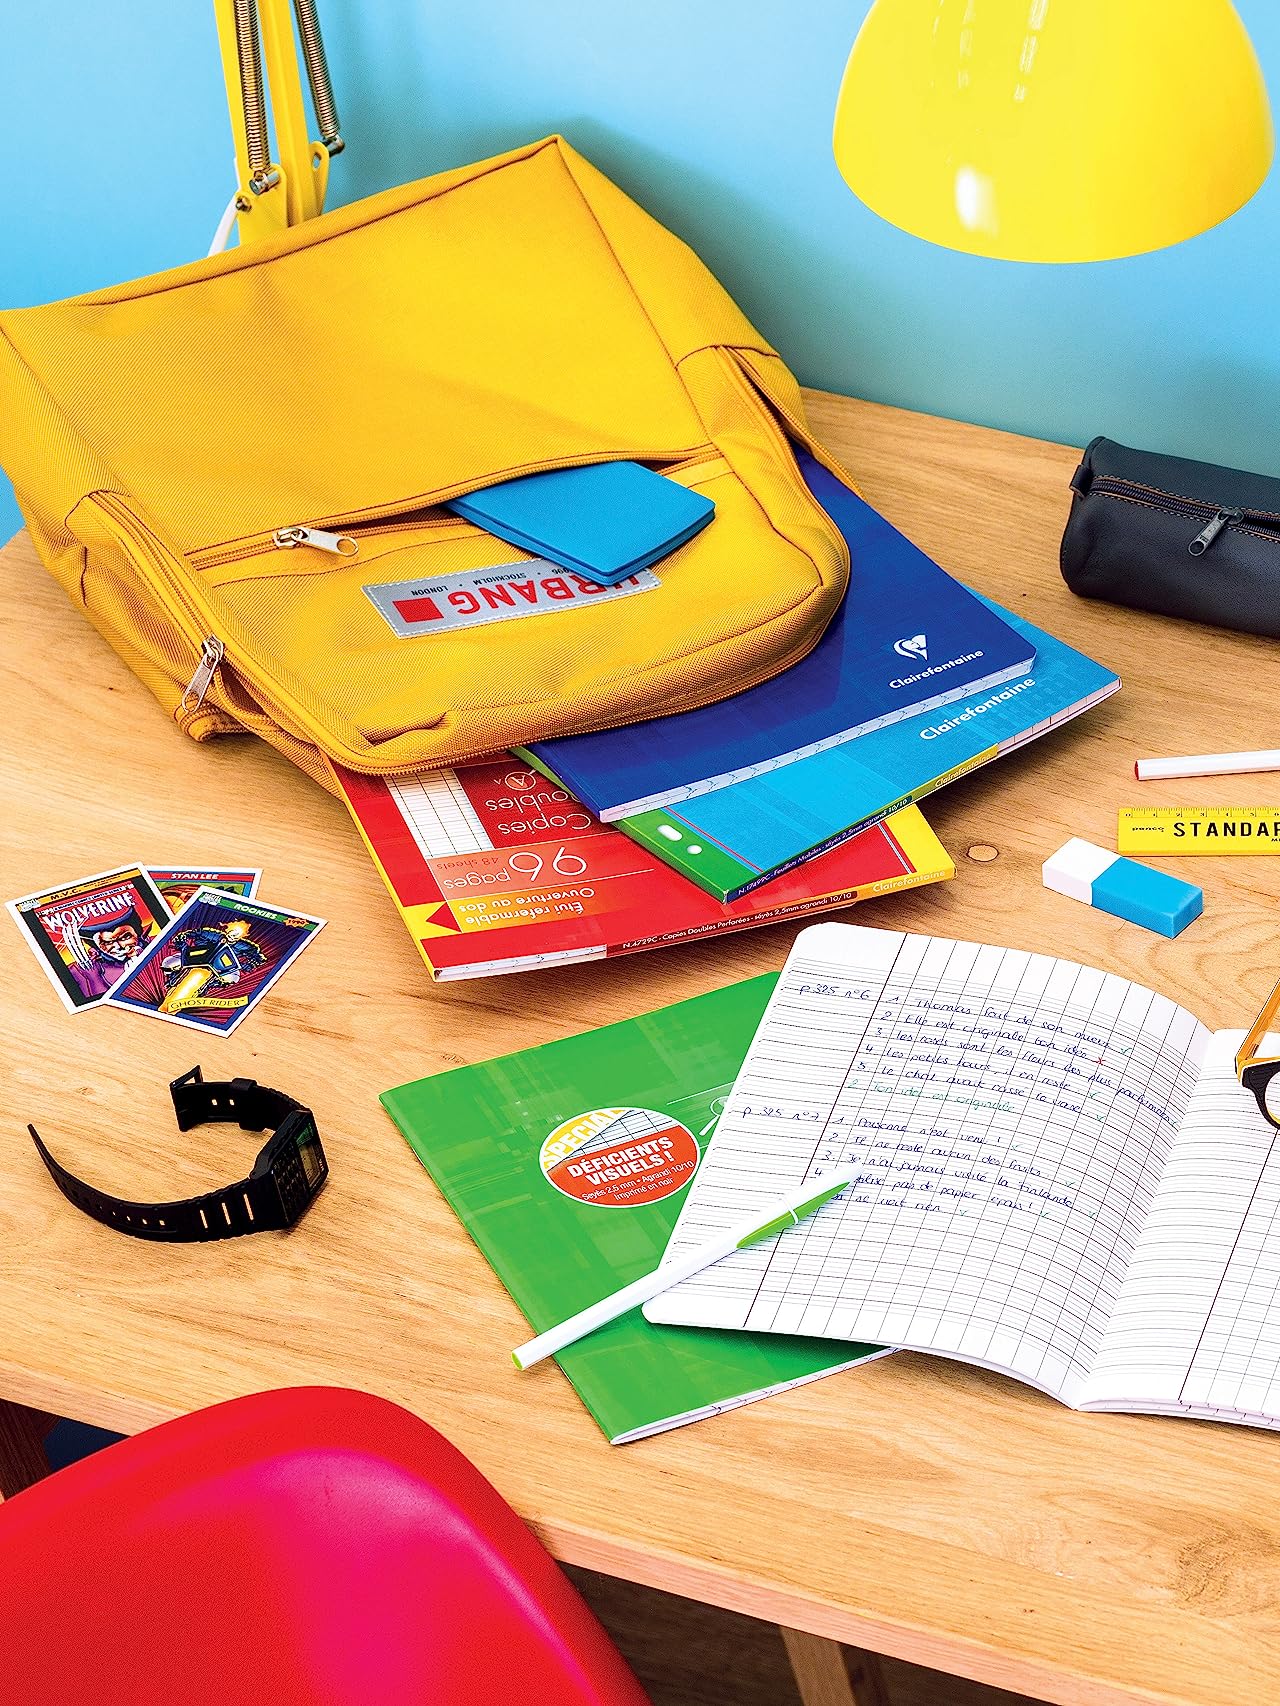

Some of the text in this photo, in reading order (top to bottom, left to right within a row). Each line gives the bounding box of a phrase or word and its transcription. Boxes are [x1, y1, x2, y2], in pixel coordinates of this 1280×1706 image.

[411, 585, 449, 595] LONDON
[472, 572, 527, 586] STOCKHOLM
[889, 648, 984, 690] Clairefontaine
[919, 677, 1036, 741] Clairefontaine
[935, 754, 992, 788] Clairefontaine
[485, 790, 582, 814] oubles
[889, 799, 908, 814] 10/10
[497, 812, 592, 835] Copies
[443, 847, 588, 890] 96 pages
[872, 869, 946, 893] Clairefontaine
[50, 888, 81, 901] M.V.C.
[458, 887, 595, 914] Ouverture au dos
[42, 892, 136, 931] WOLVERINE
[234, 903, 277, 920] ROOKIES
[465, 901, 584, 927] Étui refermable
[662, 931, 687, 942] Copies
[688, 924, 717, 936] Doubles
[717, 917, 751, 930] Perforées
[799, 897, 829, 911] agrandi
[829, 891, 853, 904] 10/10
[170, 998, 206, 1010] GHOST
[916, 998, 971, 1014] Thomas
[567, 1136, 674, 1178] DÉFICIENTS
[585, 1154, 665, 1186] VISUELS
[620, 1181, 636, 1191] mm
[642, 1169, 672, 1183] Agrandi
[672, 1160, 694, 1173] 10/10
[614, 1178, 674, 1201] Imprimé en noir
